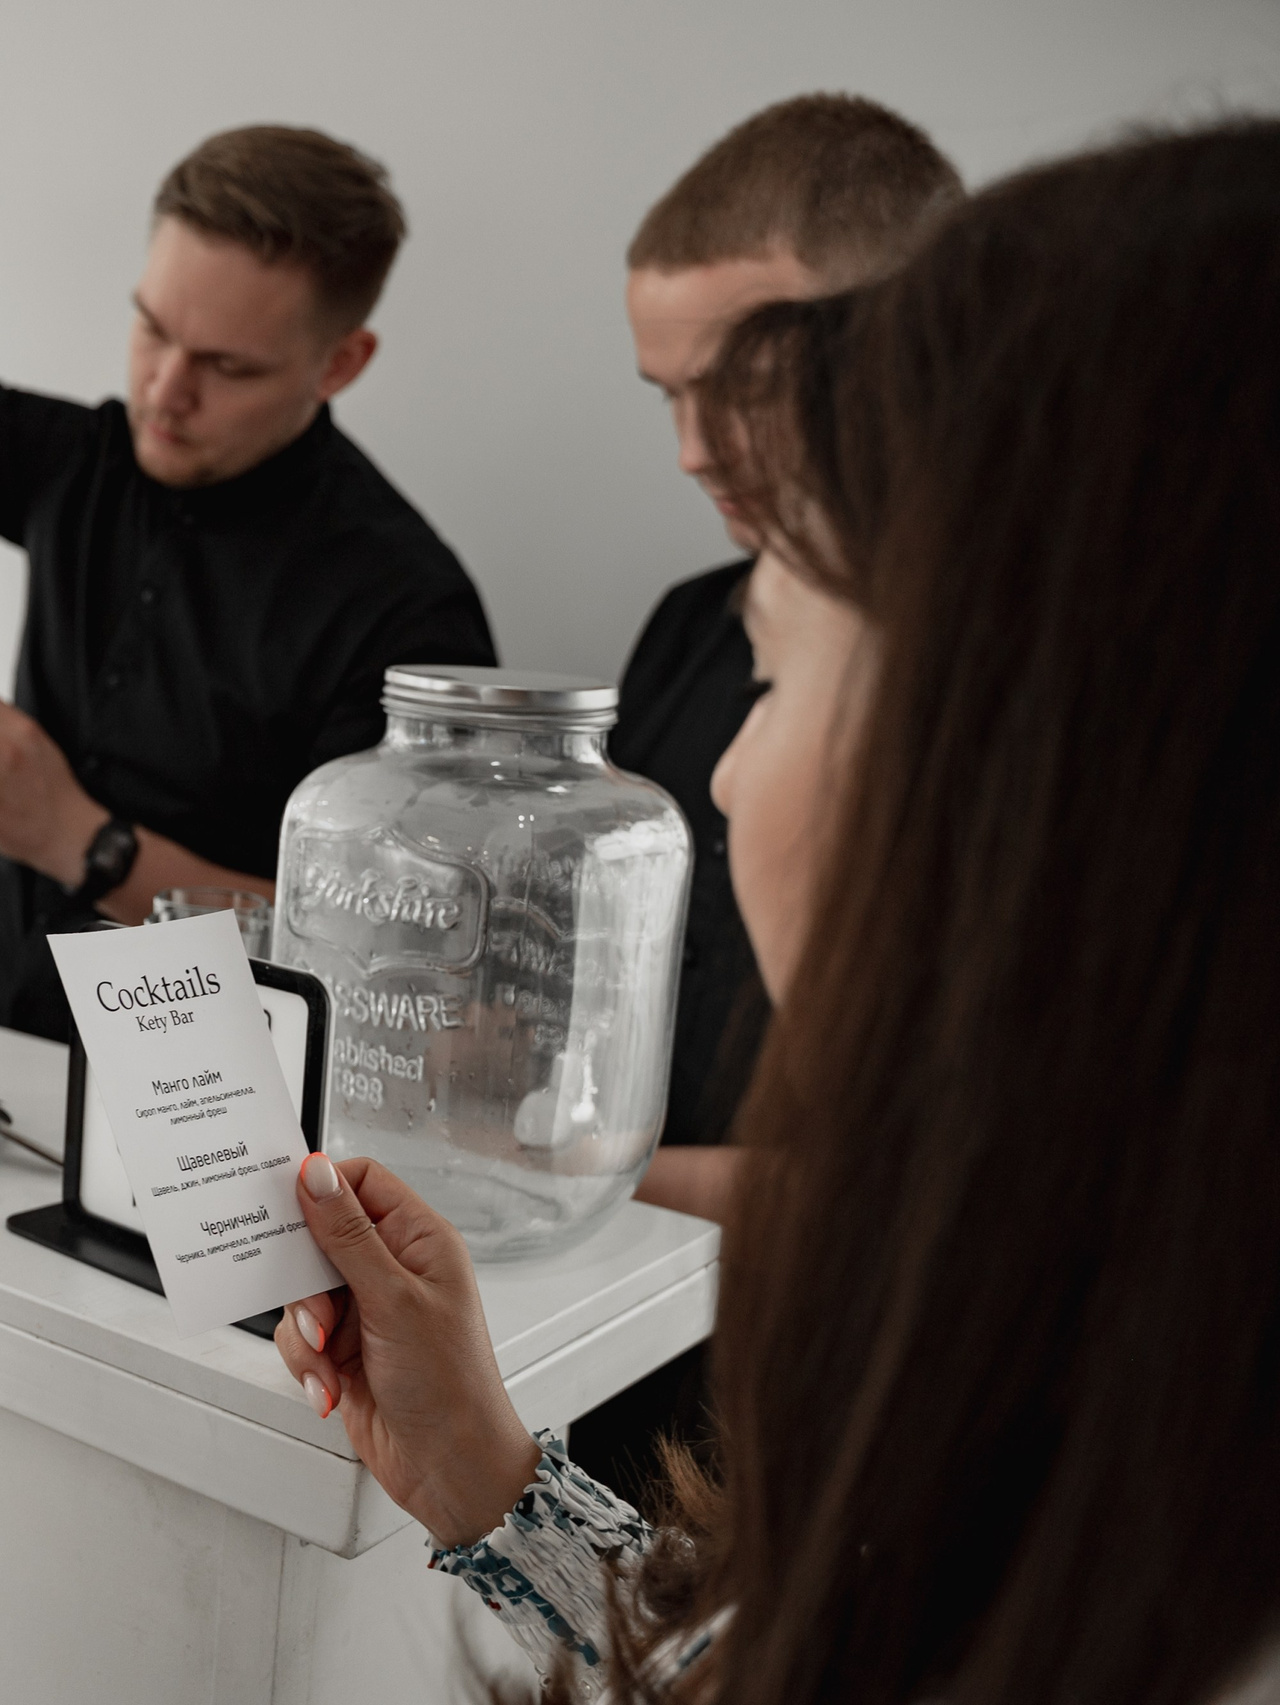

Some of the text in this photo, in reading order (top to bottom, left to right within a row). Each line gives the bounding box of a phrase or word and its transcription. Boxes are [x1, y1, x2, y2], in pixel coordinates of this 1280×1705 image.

[96, 966, 221, 1012] Cocktails
[327, 974, 464, 1032] SSWARE
[135, 1010, 195, 1033] Kety Bar
[334, 1035, 424, 1083] ablished
[152, 1069, 223, 1096] Манго лайм
[135, 1107, 157, 1119] Сироп
[157, 1103, 179, 1114] манго,
[180, 1098, 200, 1110] лайм,
[170, 1106, 228, 1125] лимонный фреш
[176, 1140, 249, 1172] Щавелевый
[151, 1155, 291, 1197] Щавель, джин, лимонный фреш, содовая
[200, 1205, 270, 1237] Черничный
[175, 1249, 206, 1264] Черника,
[250, 1224, 286, 1243] лимонный
[232, 1247, 262, 1263] содовая
